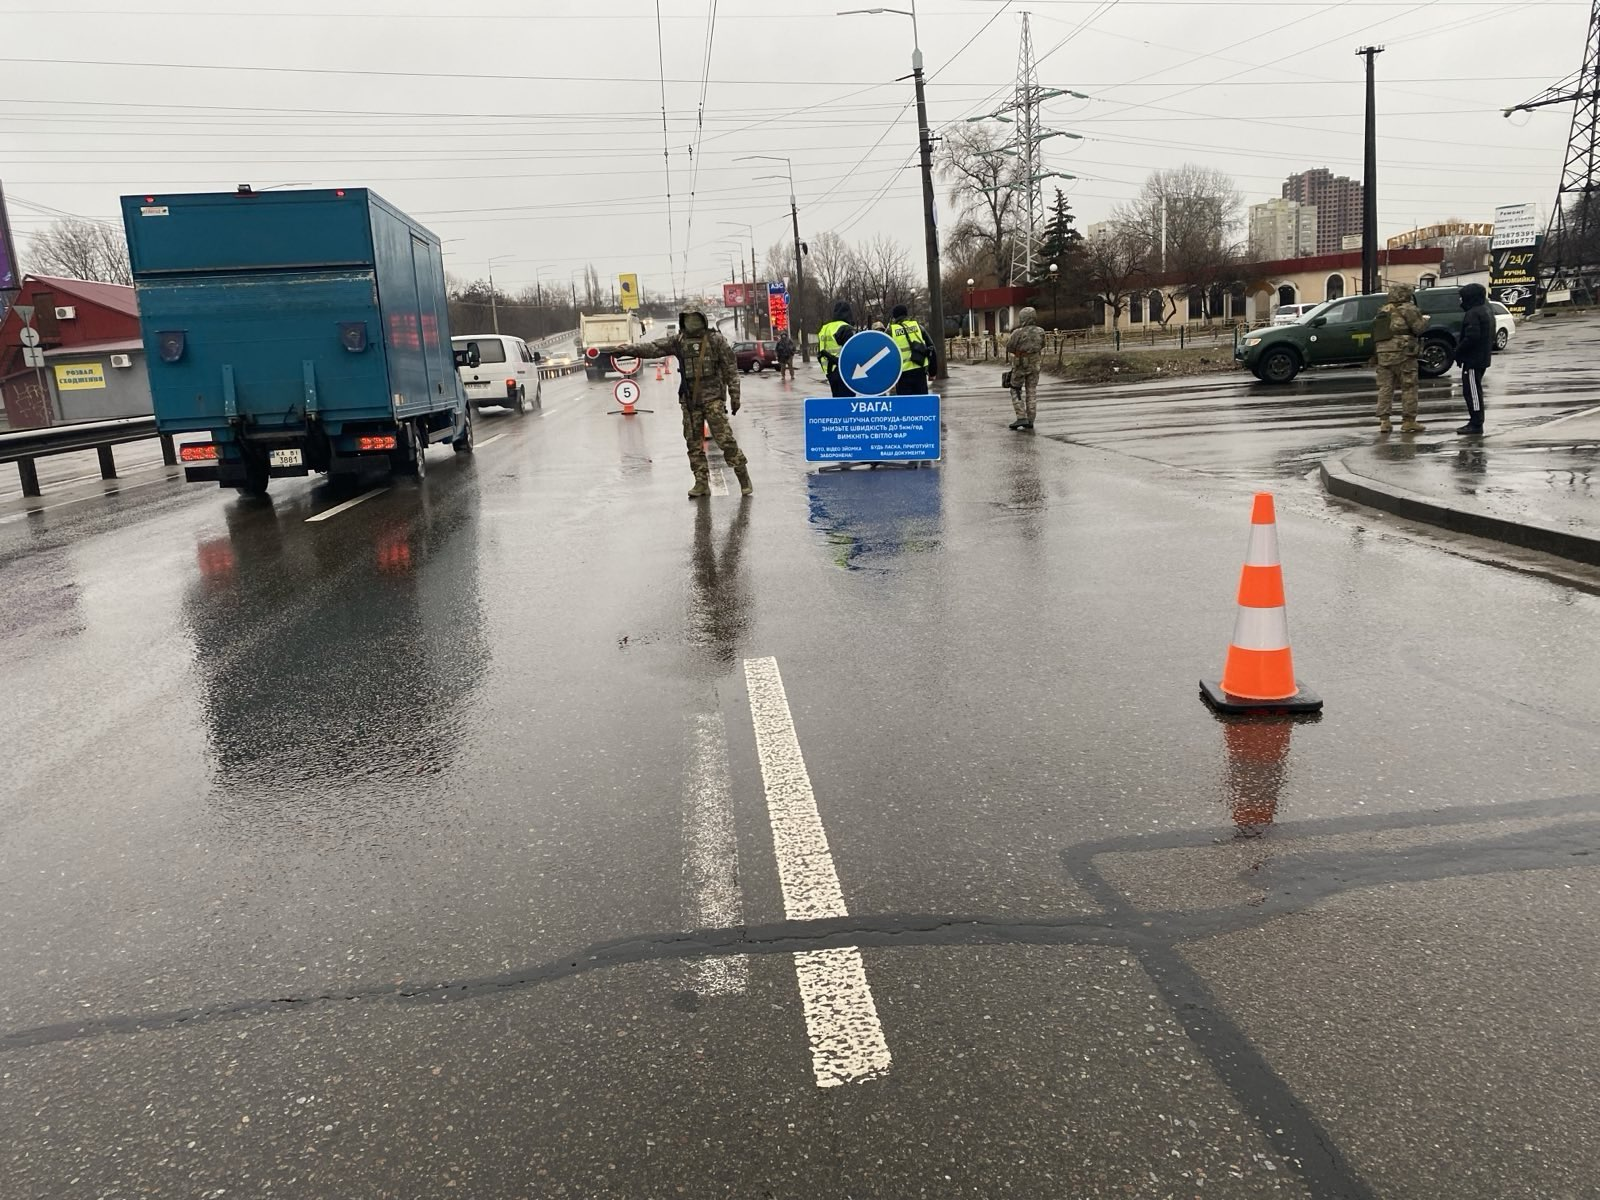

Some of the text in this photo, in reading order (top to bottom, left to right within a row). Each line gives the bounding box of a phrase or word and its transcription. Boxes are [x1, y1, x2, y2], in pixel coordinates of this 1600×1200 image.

[1510, 253, 1534, 266] 24/7
[1493, 276, 1536, 284] АВТОМИЙКА
[623, 387, 632, 398] 5
[851, 401, 892, 413] УВАГА!
[870, 415, 937, 423] СПОРУДА-БЛОКПОСТ
[850, 424, 888, 432] ШВИДКІСТЬ
[899, 423, 924, 431] 5км/год
